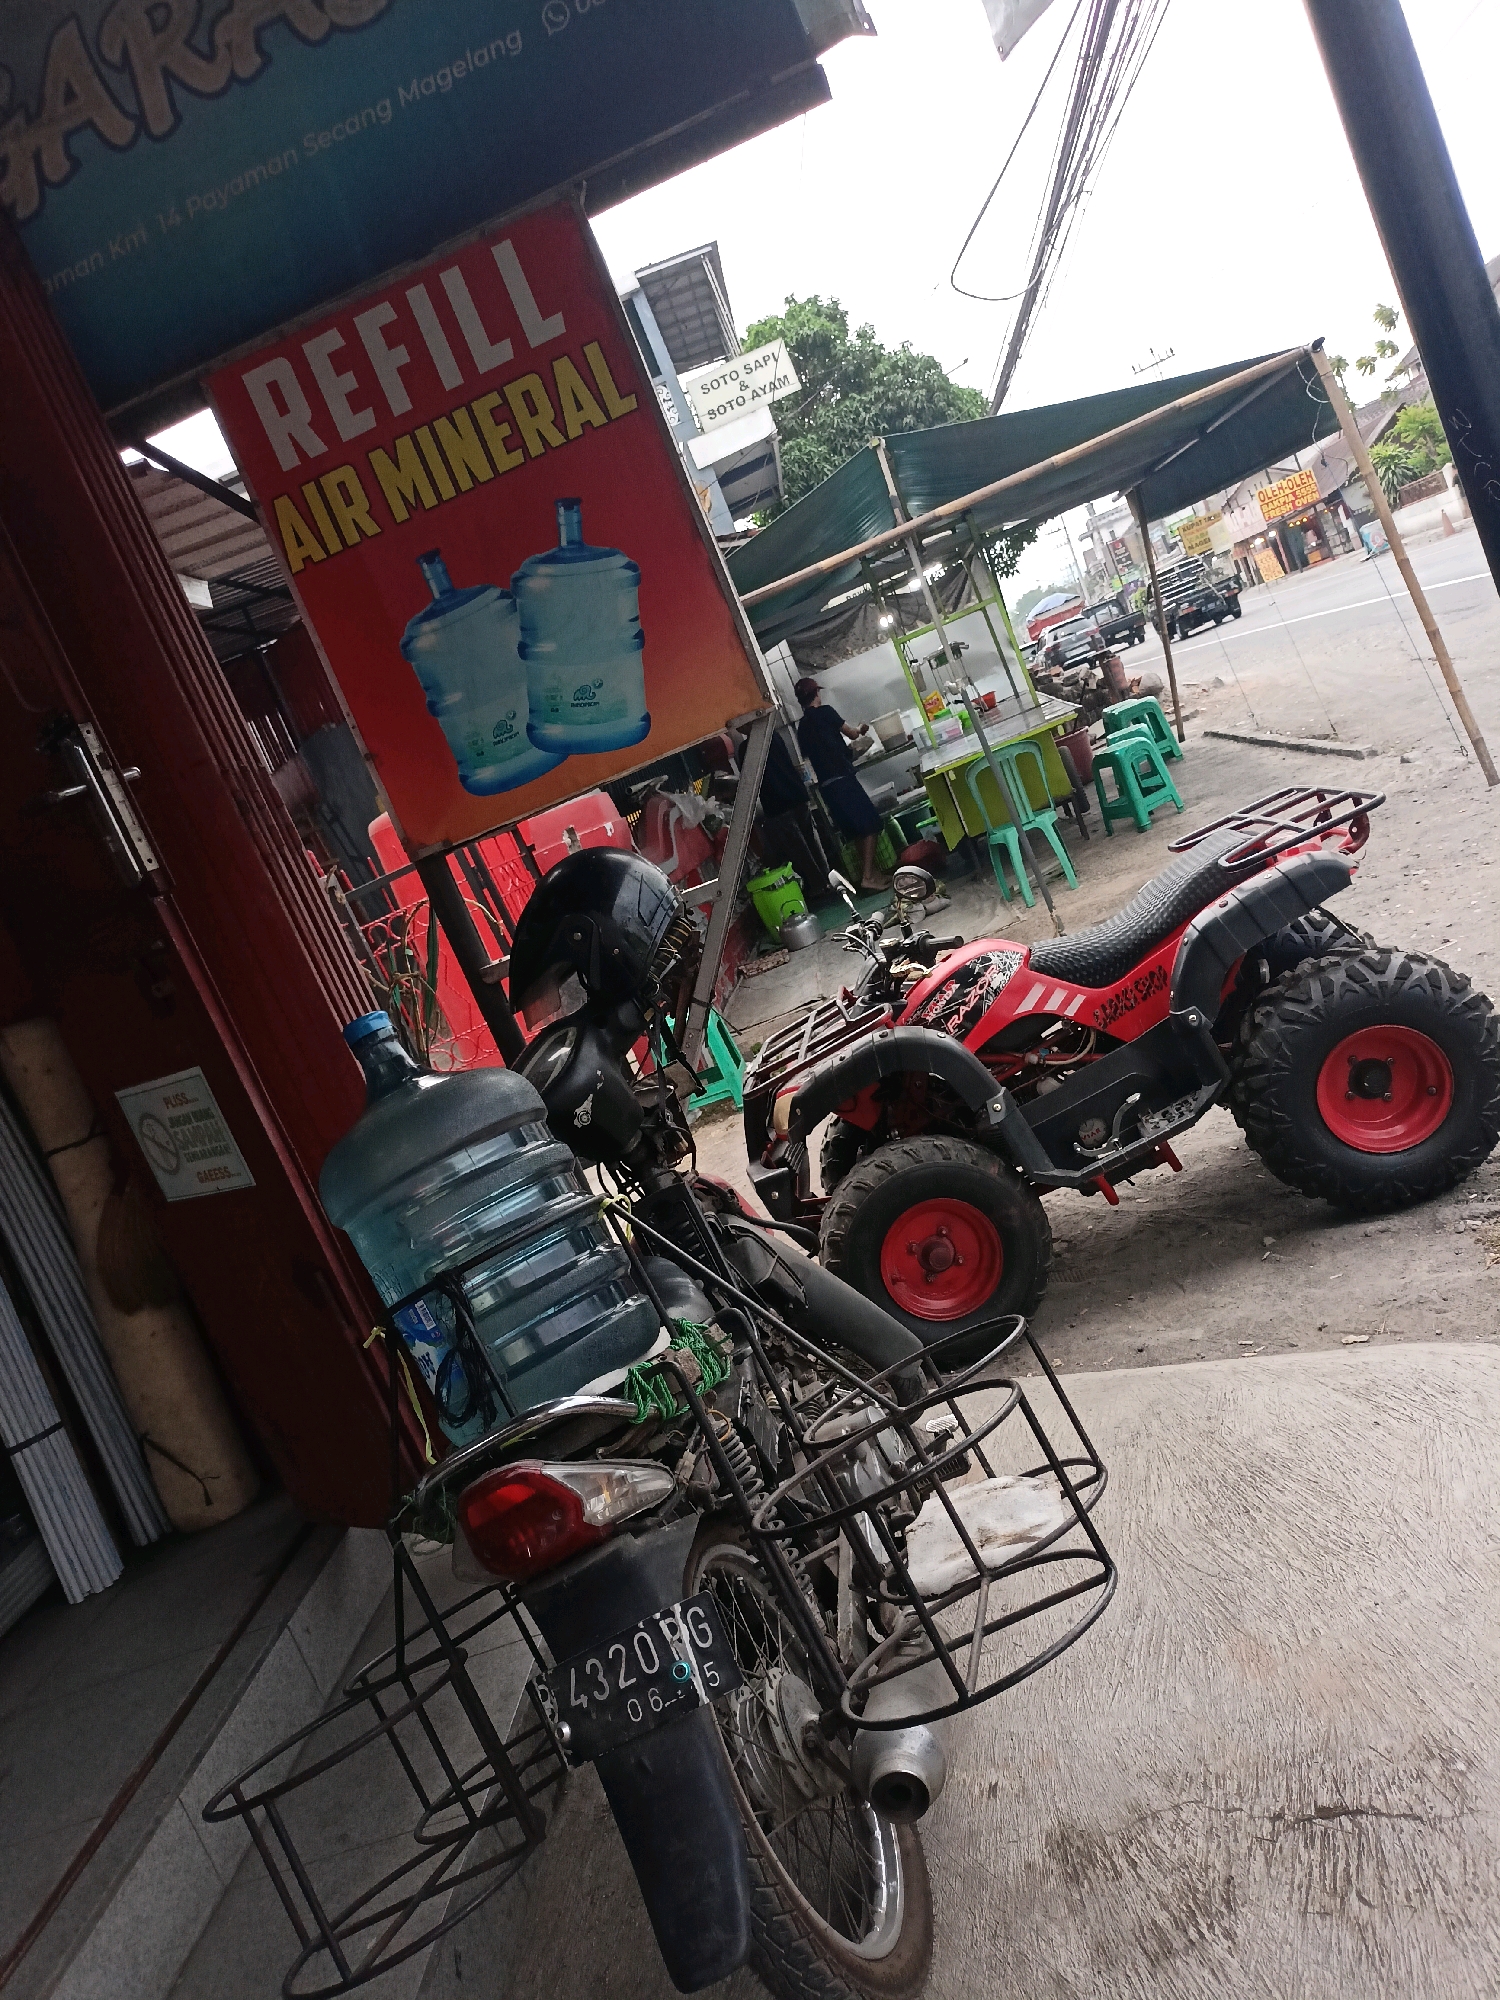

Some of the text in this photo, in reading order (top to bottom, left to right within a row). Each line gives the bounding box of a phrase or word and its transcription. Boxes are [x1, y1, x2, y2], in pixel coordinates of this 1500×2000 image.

[157, 209, 182, 236] 14
[187, 149, 299, 219] Payaman
[302, 99, 394, 156] Secang
[398, 28, 524, 107] Magelang
[242, 239, 566, 472] REFILL
[701, 352, 778, 394] SOTO SAPI
[708, 375, 790, 420] SOTO AYAM
[739, 380, 749, 391] &
[273, 341, 638, 574] AIR MINERAL
[1258, 470, 1314, 502] OLEH-OLEH
[1262, 494, 1294, 512] BAKPIA
[1264, 504, 1292, 520] FRESH
[1295, 492, 1318, 506] OVEN
[925, 984, 960, 1022] HONDA
[947, 964, 1000, 1033] RAZOR
[1132, 964, 1168, 1001] SHOP
[571, 1632, 660, 1708] 4320
